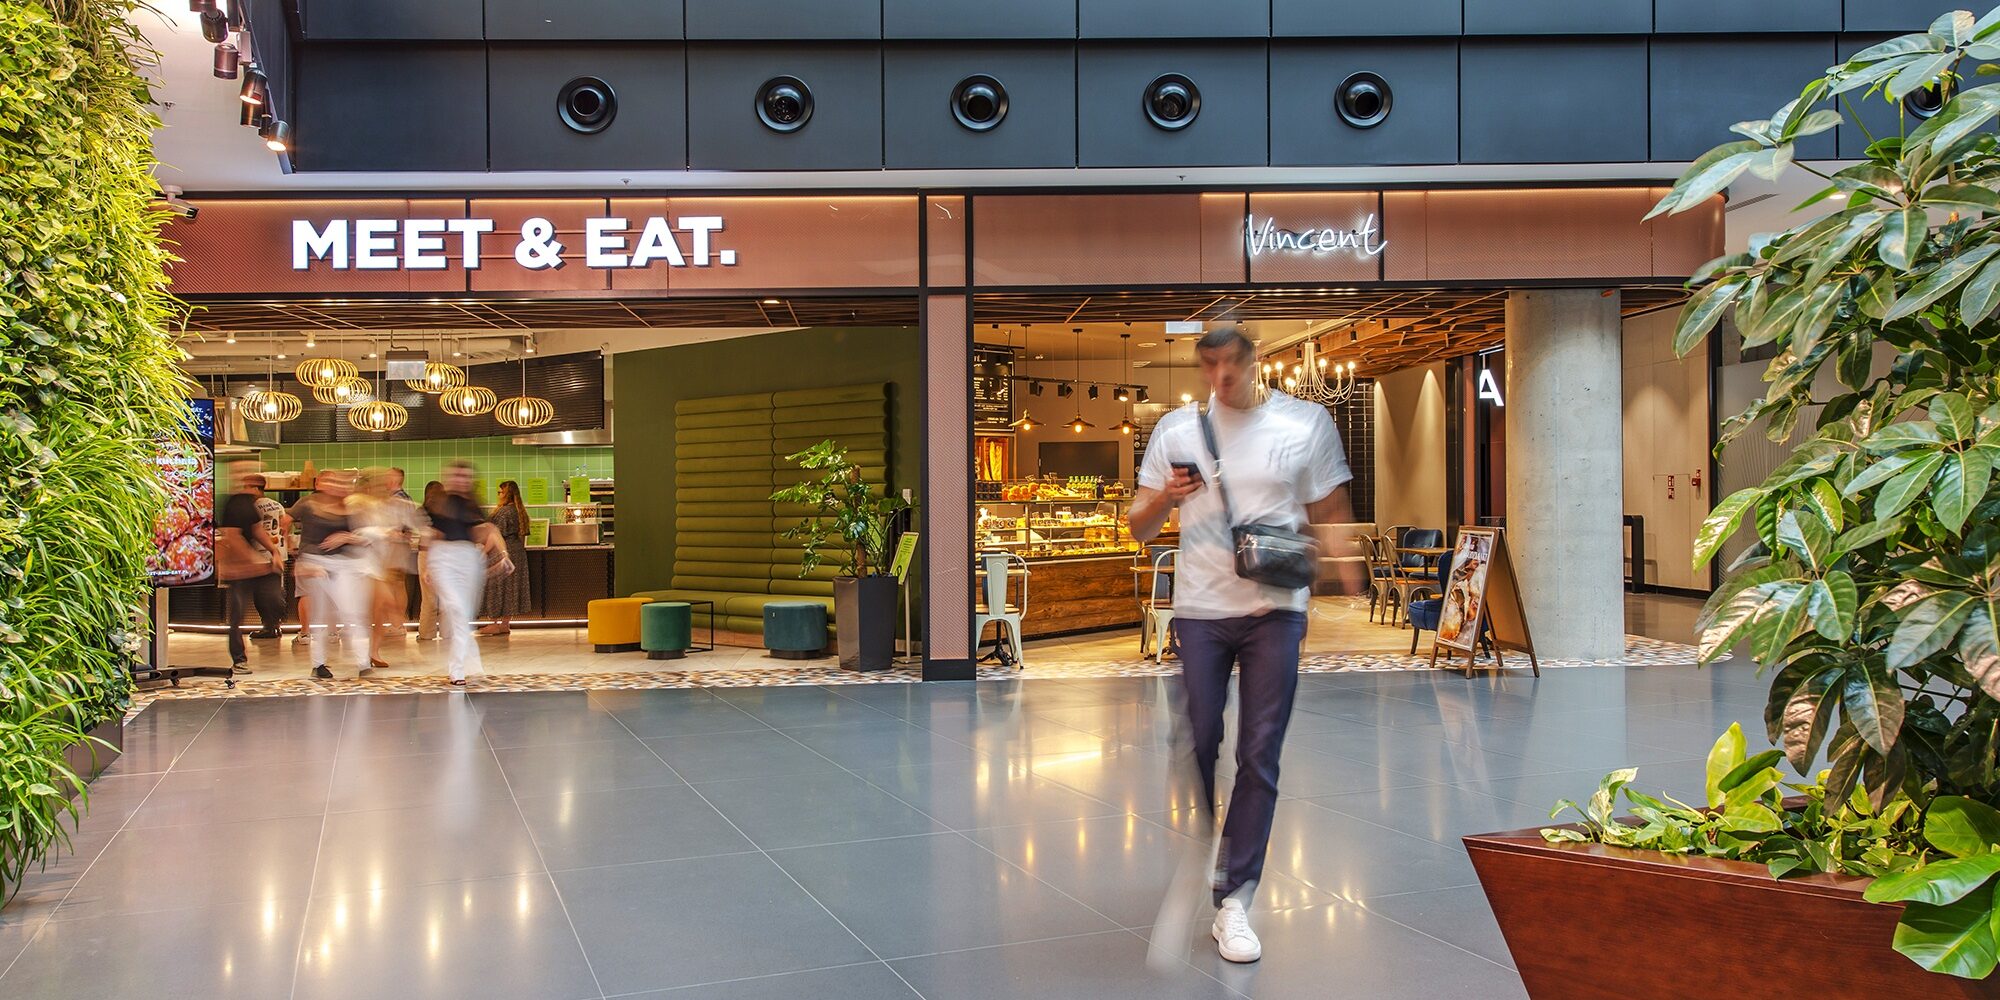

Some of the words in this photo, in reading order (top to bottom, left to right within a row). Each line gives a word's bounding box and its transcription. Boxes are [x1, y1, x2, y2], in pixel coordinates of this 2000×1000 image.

[292, 218, 494, 269] MEET
[514, 216, 563, 269] &
[586, 216, 736, 268] EAT.
[1247, 213, 1388, 256] Vincent
